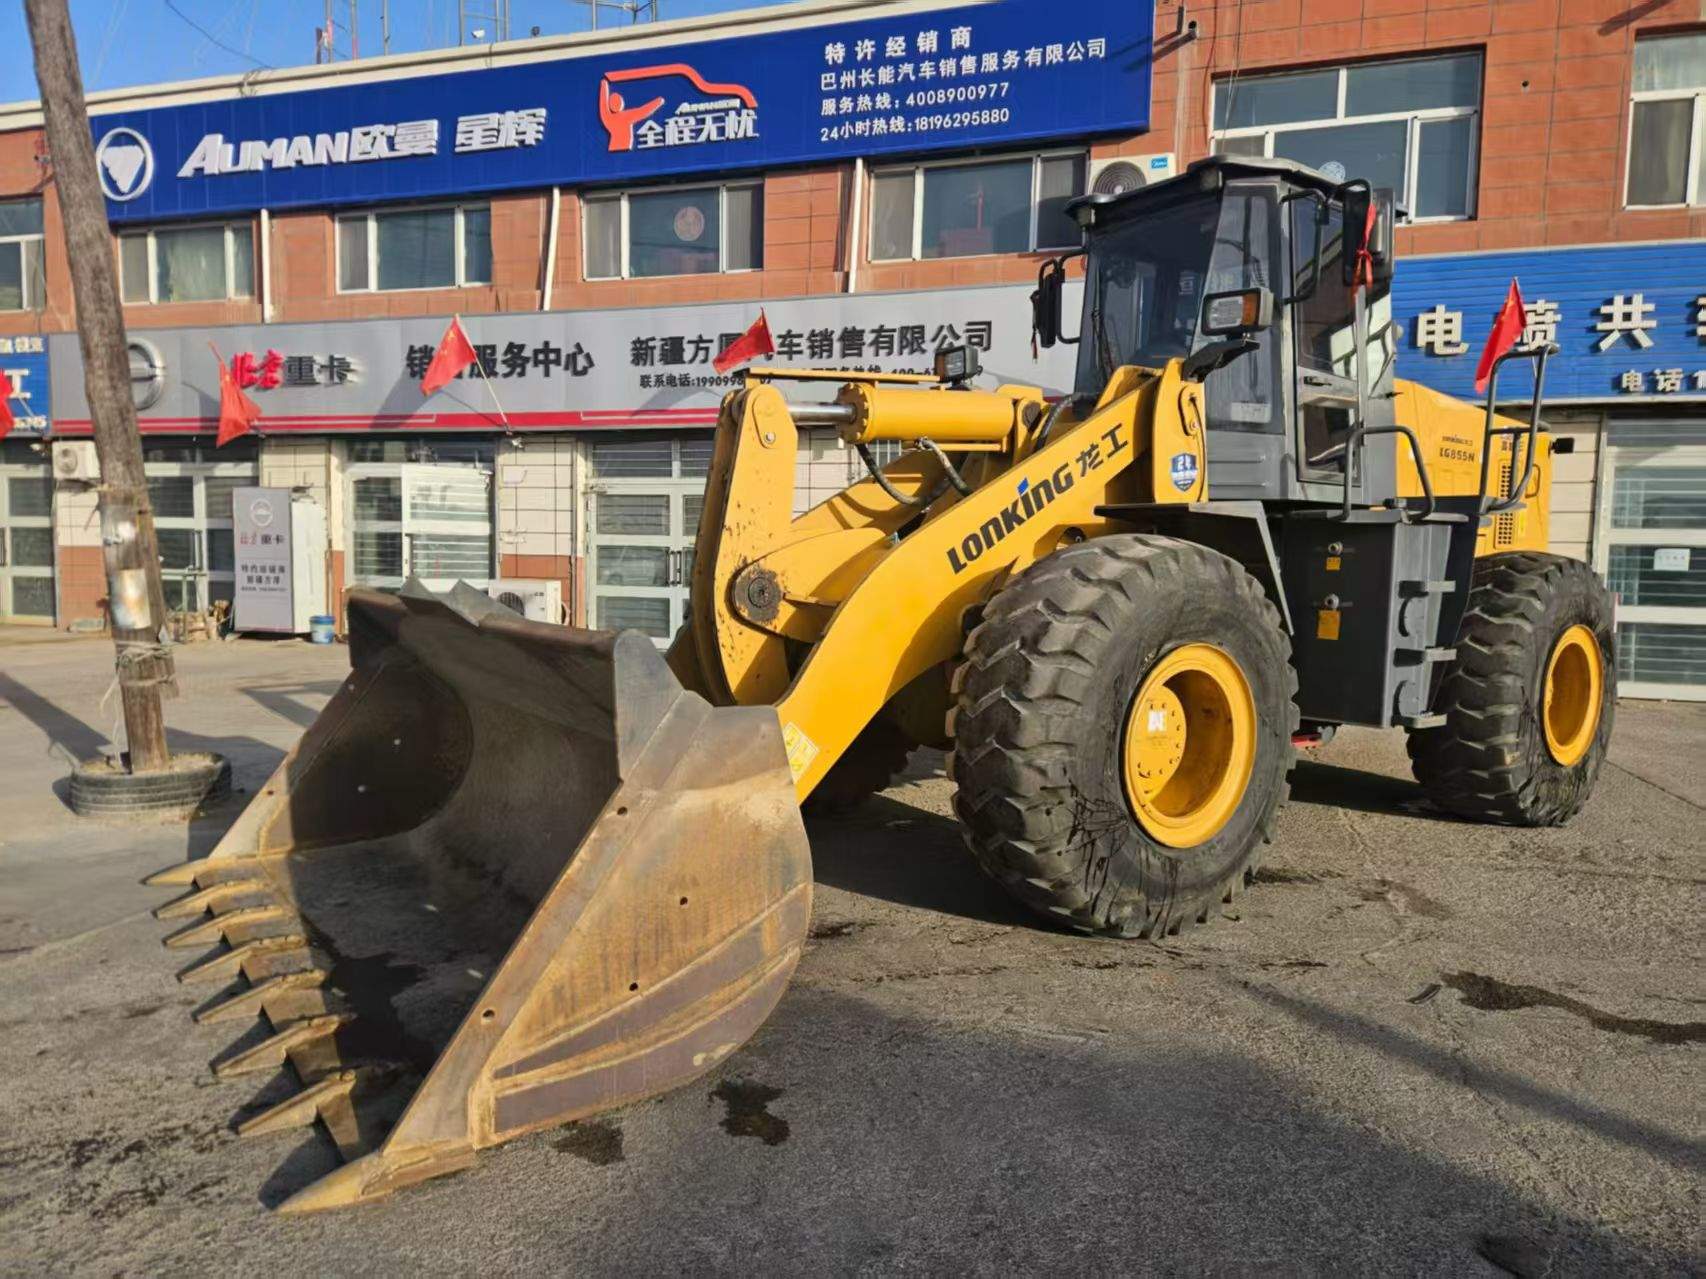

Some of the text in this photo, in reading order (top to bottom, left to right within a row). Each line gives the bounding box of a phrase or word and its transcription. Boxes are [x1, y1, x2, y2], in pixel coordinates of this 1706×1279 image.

[820, 38, 1107, 91] 巴州长能汽车销售服务有限公司
[825, 26, 972, 65] 特许经销商
[455, 108, 547, 152] 星辉
[637, 109, 759, 149] 全程无忧
[820, 108, 1010, 142] 24小时热线:18196295880
[630, 320, 992, 367] 新疆方车销售有限公司
[1417, 293, 1706, 356] 电喷共
[406, 340, 595, 379] 销服务中心
[1075, 423, 1129, 478] 龙工
